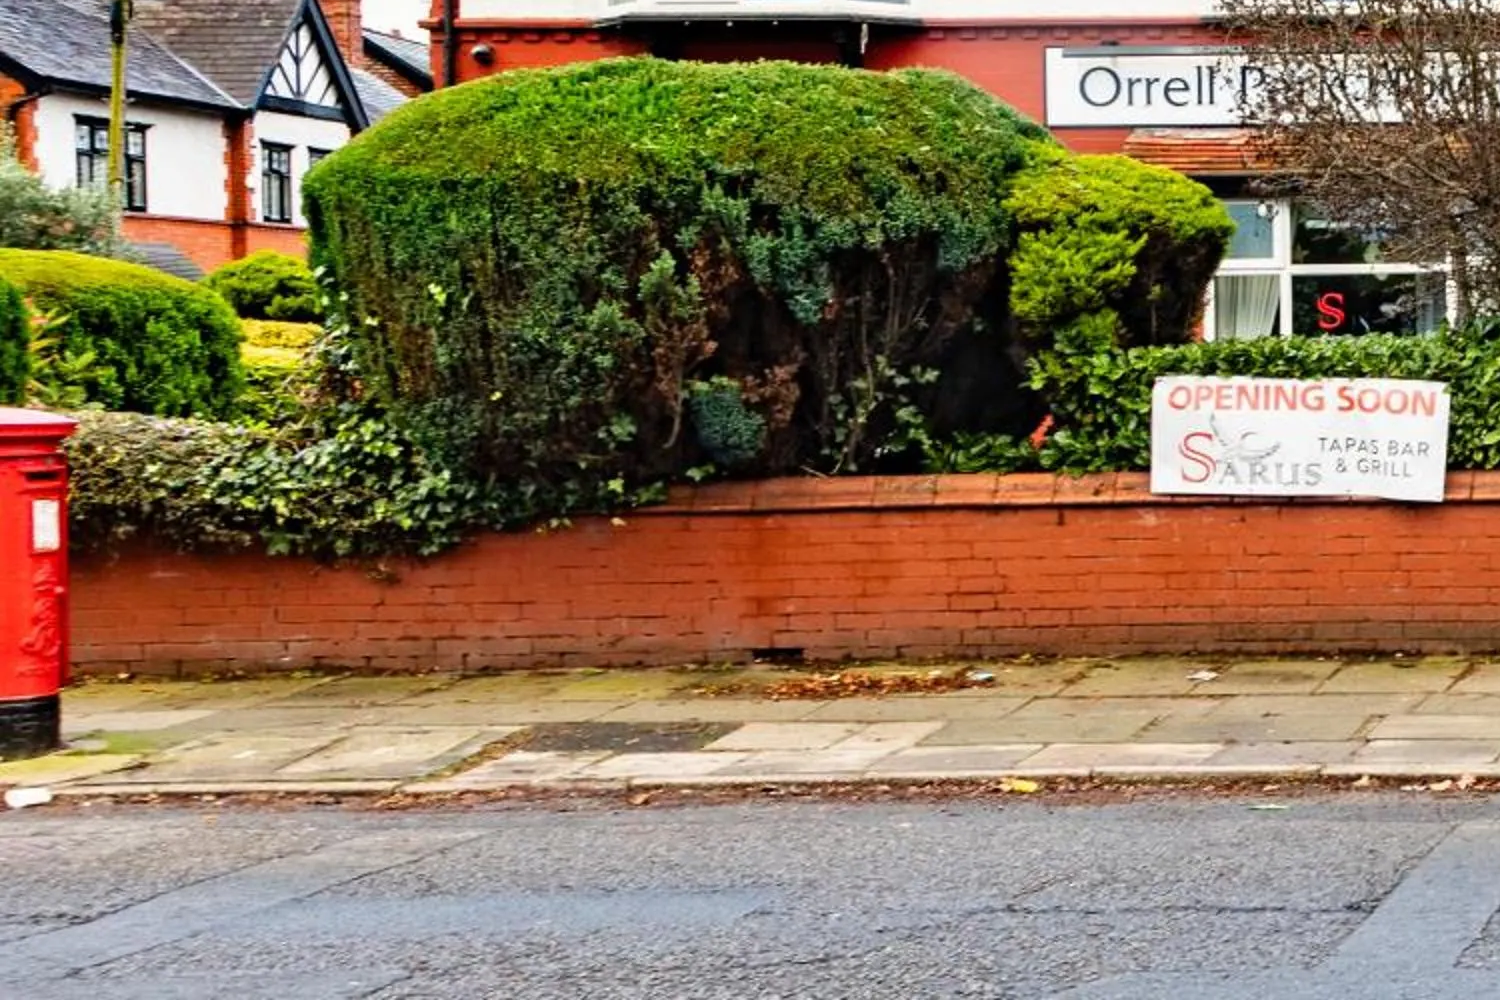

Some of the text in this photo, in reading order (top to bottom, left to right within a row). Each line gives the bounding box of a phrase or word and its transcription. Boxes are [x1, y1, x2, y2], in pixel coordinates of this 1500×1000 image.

[1078, 64, 1216, 108] Orrell
[1317, 292, 1345, 329] S
[1167, 384, 1438, 417] OPENING SOON
[1317, 436, 1431, 458] TAPAS BAR
[1334, 458, 1413, 478] & GRILL
